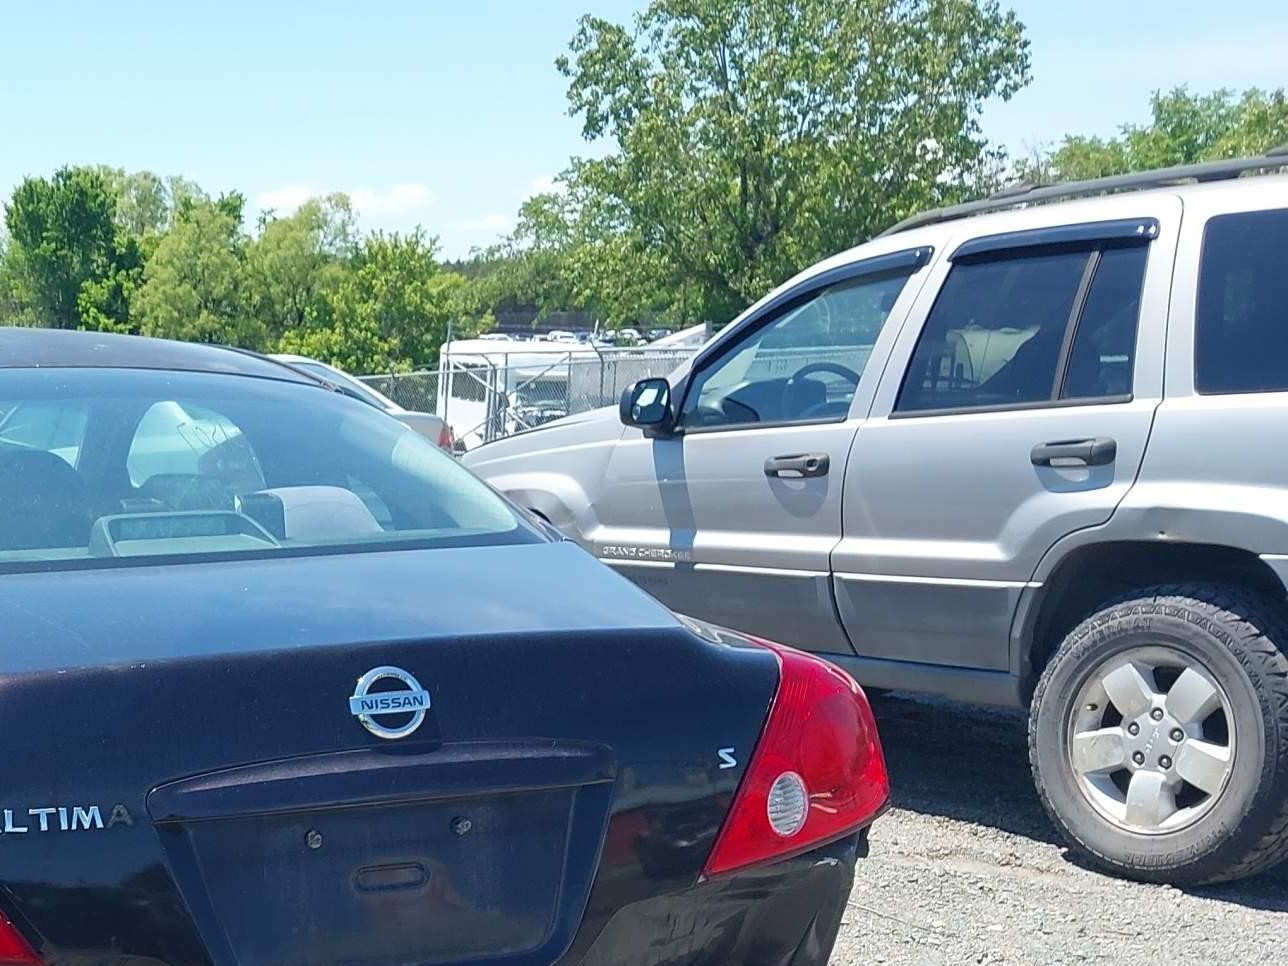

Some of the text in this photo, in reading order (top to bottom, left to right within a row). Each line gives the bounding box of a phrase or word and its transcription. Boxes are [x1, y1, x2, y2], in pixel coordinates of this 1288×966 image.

[602, 545, 692, 560] GRAND CHEROKEE
[361, 695, 424, 710] NISSAN
[718, 747, 737, 769] S
